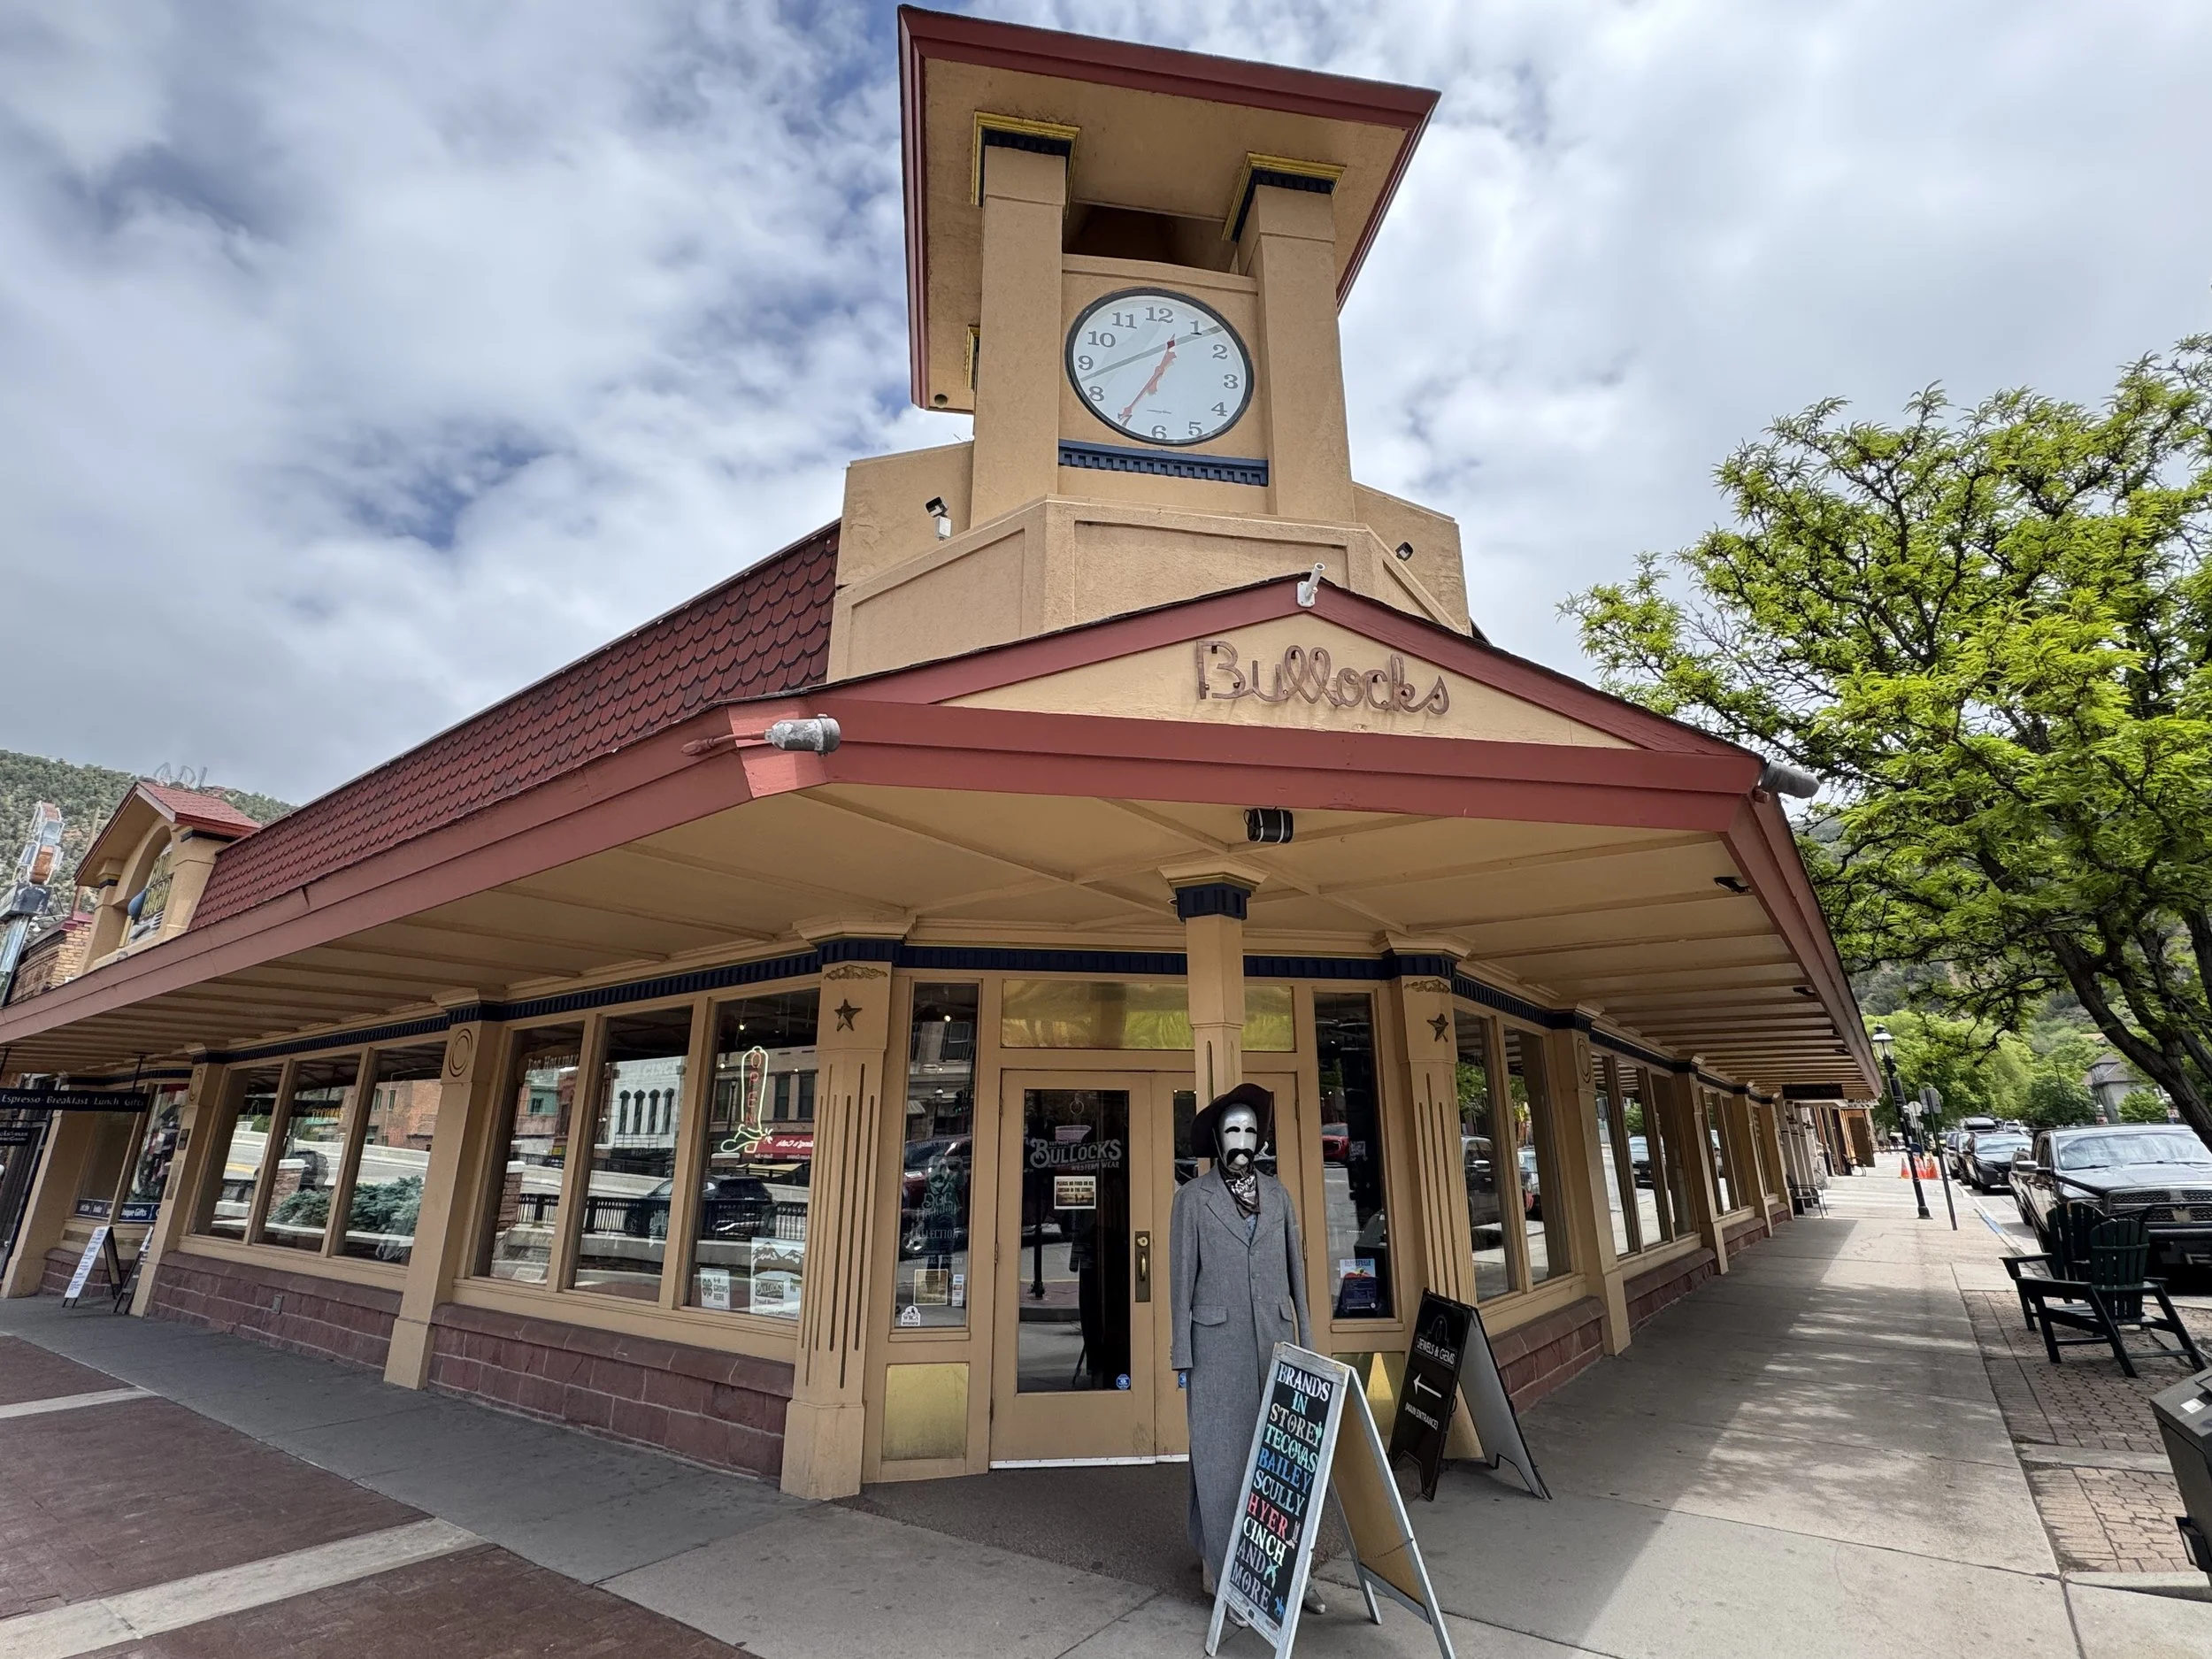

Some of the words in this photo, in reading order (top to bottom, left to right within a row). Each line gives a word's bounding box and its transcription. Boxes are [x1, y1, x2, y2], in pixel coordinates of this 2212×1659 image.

[1111, 311, 1138, 329] 11
[1145, 306, 1174, 324] 12
[1190, 320, 1202, 336] 1
[1087, 330, 1117, 348] 10
[1212, 344, 1228, 360] 2
[1078, 355, 1094, 371] 9
[1088, 386, 1105, 402] 8
[1223, 373, 1239, 389] 3
[1117, 411, 1133, 427] 7
[1210, 402, 1228, 417] 4
[1151, 425, 1168, 441] 6
[1187, 421, 1203, 437] 5
[1195, 640, 1451, 716] Bullocks
[1, 1094, 42, 1104] Espresso
[46, 1095, 88, 1105] Breakfast
[93, 1097, 119, 1106] Lunch
[745, 1051, 762, 1126] OPEN
[1030, 1139, 1122, 1169] BULLOCKS
[1417, 1337, 1435, 1356] JEWELS
[1439, 1348, 1455, 1365] GEMS
[1277, 1363, 1331, 1402] BRANDS
[1290, 1390, 1308, 1416] IN
[1270, 1402, 1318, 1448] STORE
[1263, 1423, 1318, 1473] TECOVAS
[1257, 1448, 1313, 1494] BAILEY
[1253, 1469, 1306, 1517] SCULLY
[1247, 1493, 1289, 1539] HYER
[1243, 1517, 1287, 1566] CINCH
[1236, 1541, 1267, 1575] AND
[1231, 1563, 1271, 1612] MORE
